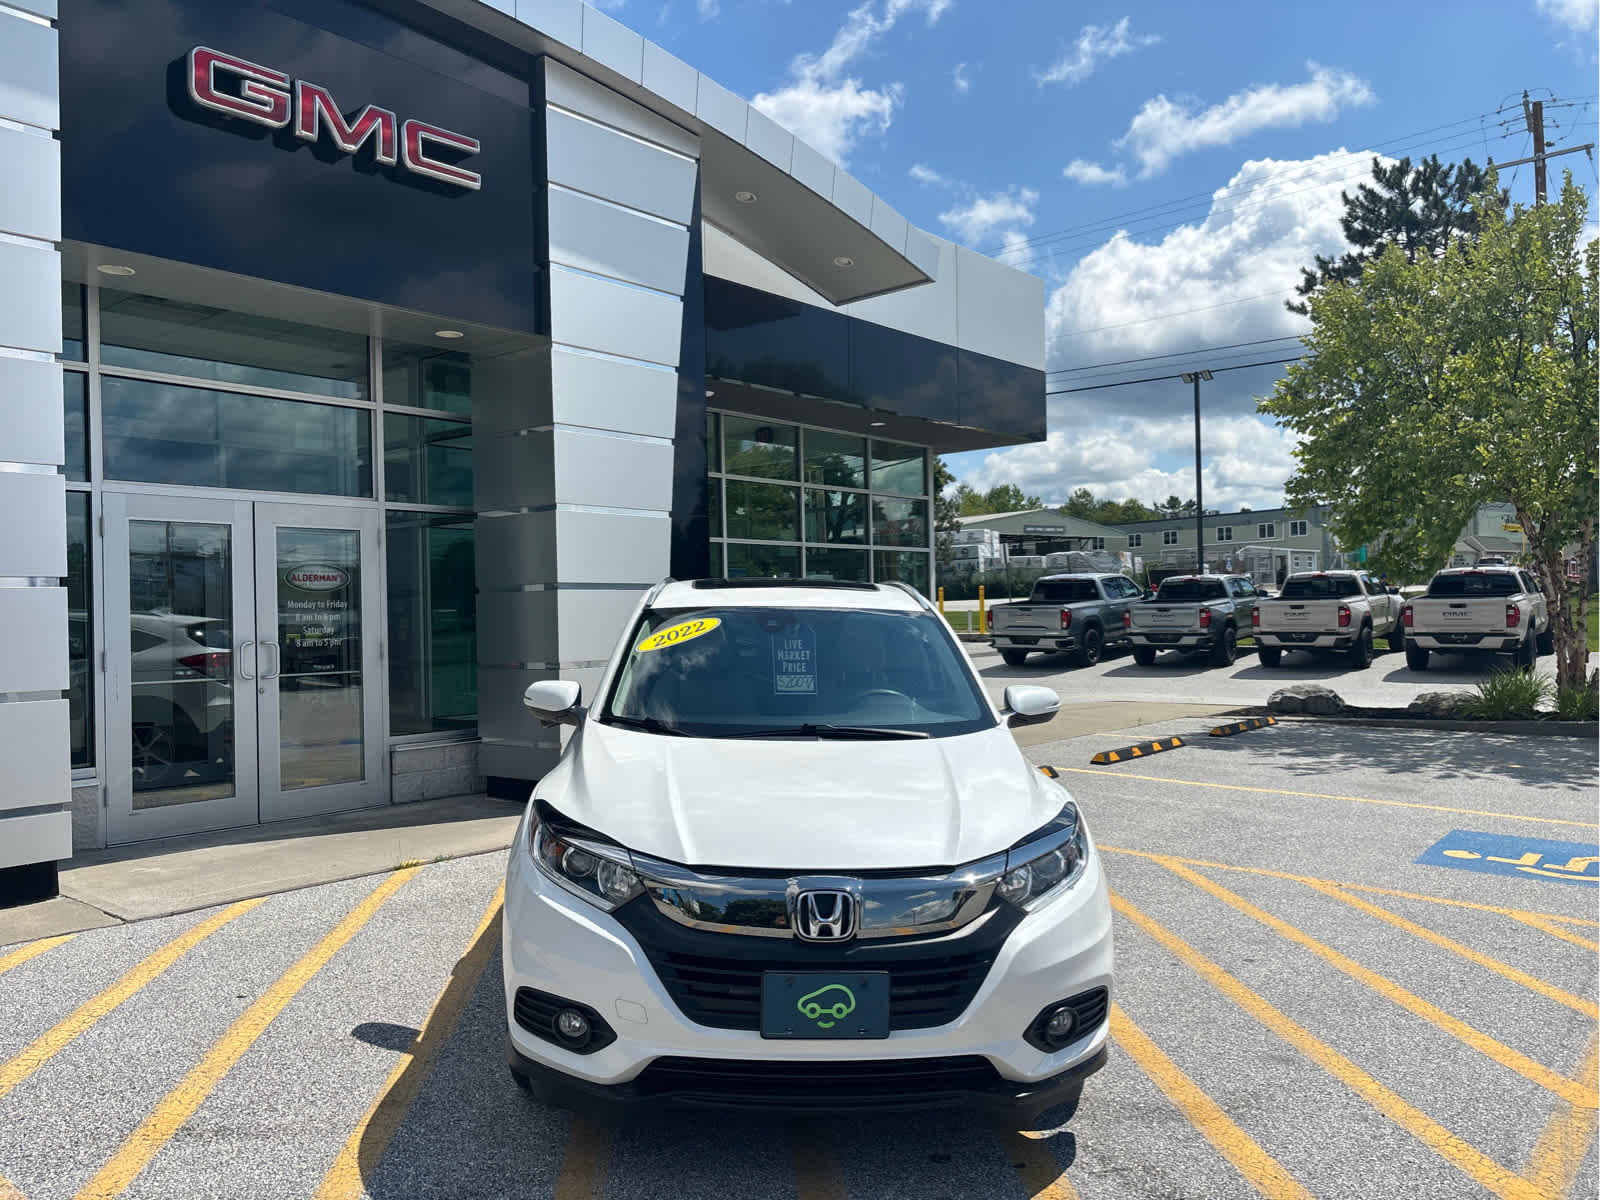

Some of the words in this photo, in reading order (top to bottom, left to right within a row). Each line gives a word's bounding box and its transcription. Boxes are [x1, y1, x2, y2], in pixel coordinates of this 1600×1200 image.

[187, 46, 481, 190] GMC
[291, 574, 345, 582] ALDERMAN'S
[287, 600, 316, 609] Monday
[317, 600, 325, 608] to
[326, 599, 348, 609] Friday
[314, 613, 322, 621] to
[329, 614, 341, 623] pm
[303, 625, 334, 635] Saturday
[653, 621, 706, 648] 2022
[295, 639, 301, 648] 8
[302, 640, 313, 648] am
[315, 639, 323, 648] to
[323, 639, 329, 647] 5
[329, 640, 341, 649] pm
[784, 639, 803, 650] LIVE
[777, 649, 811, 661] MARKET
[782, 661, 807, 673] PRICE
